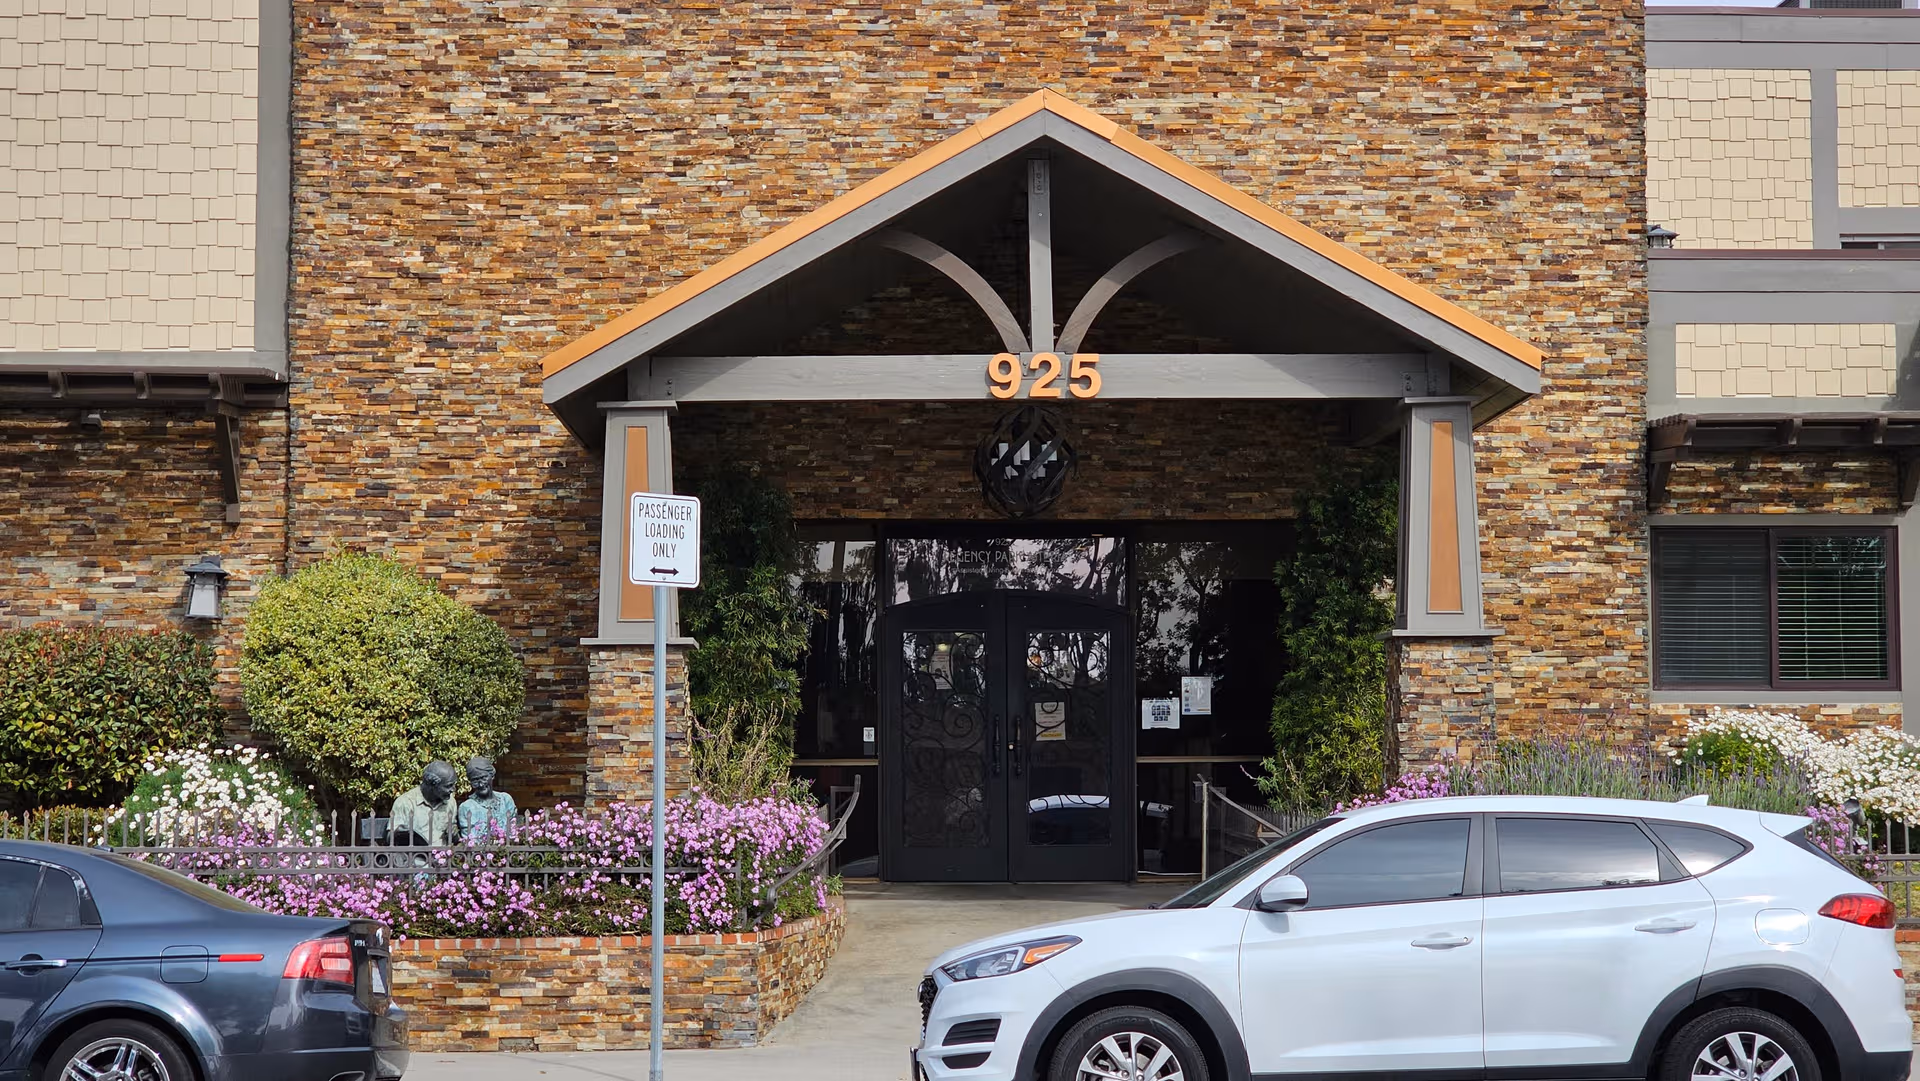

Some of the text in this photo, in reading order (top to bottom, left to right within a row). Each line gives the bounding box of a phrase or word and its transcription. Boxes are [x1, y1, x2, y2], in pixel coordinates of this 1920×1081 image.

[988, 352, 1102, 399] 925
[638, 502, 692, 521] PASSENGER
[645, 522, 685, 540] LOADING
[652, 542, 677, 558] ONLY
